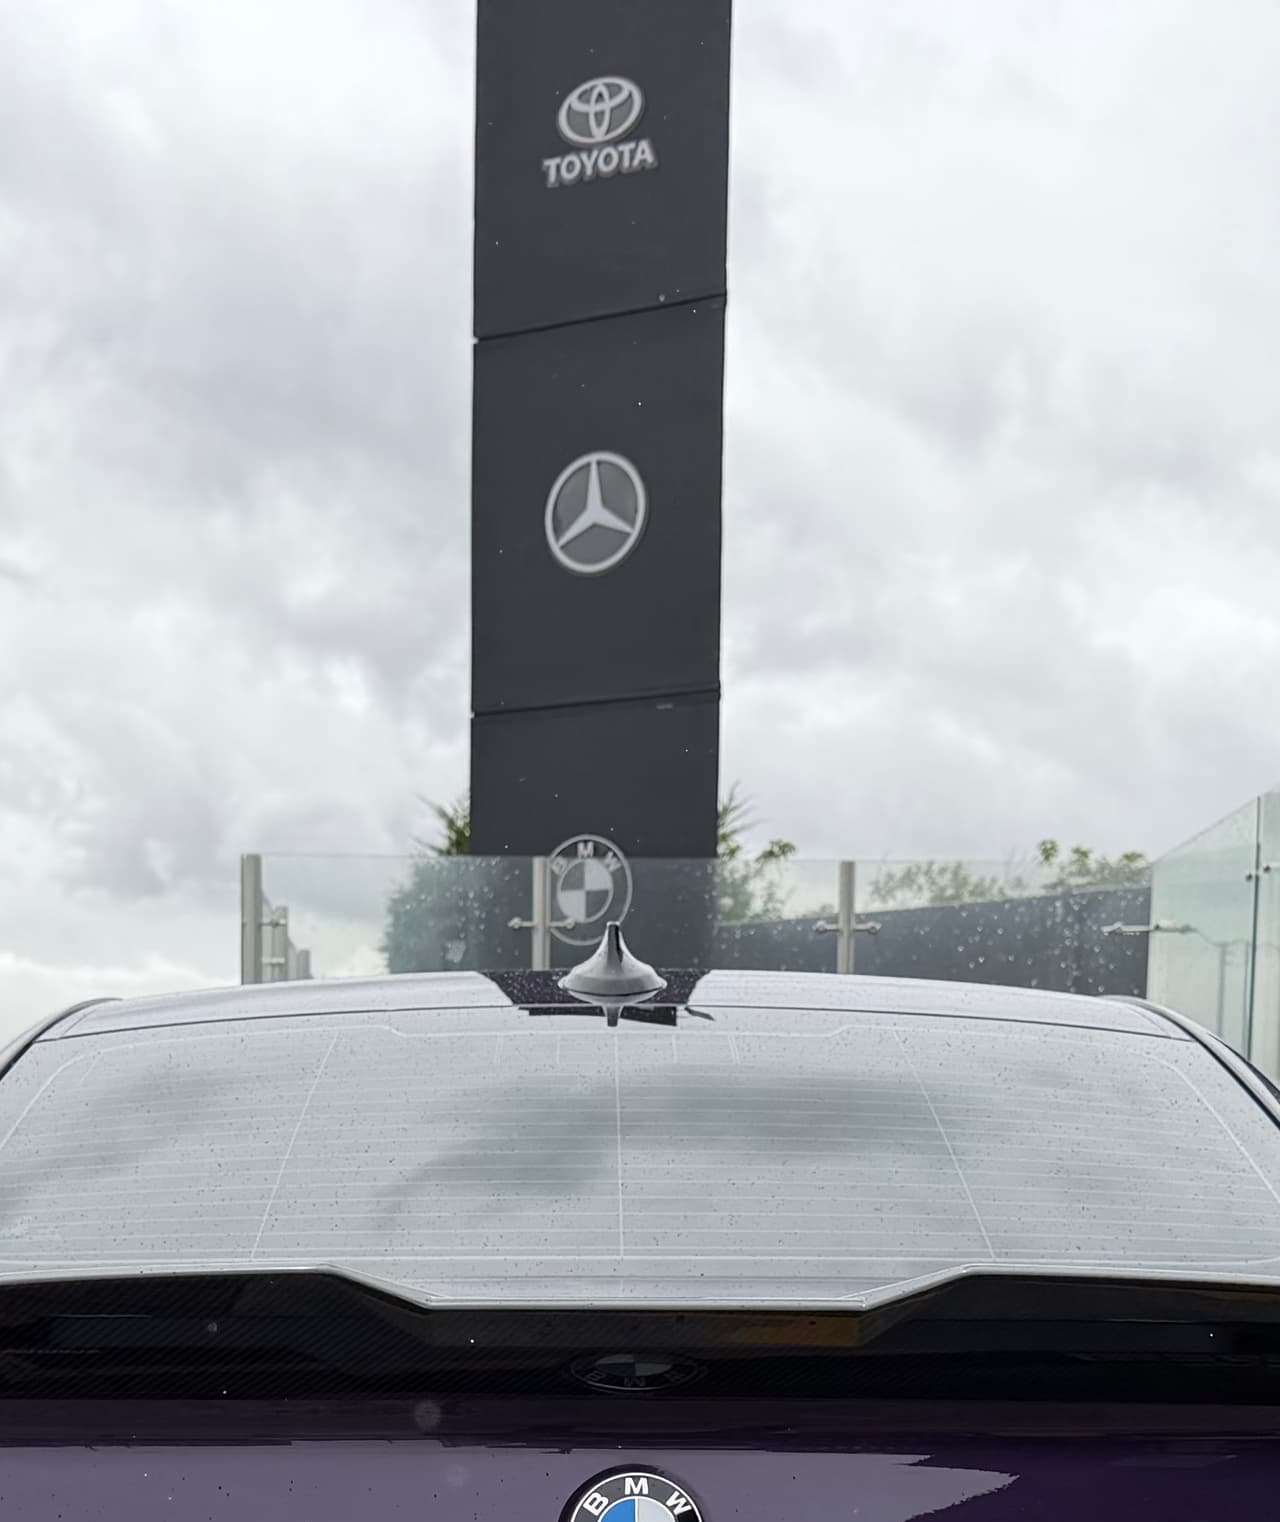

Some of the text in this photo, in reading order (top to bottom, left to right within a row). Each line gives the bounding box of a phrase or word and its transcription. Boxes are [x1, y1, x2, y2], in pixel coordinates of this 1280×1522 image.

[543, 138, 657, 187] TOYOTA
[551, 841, 622, 875] BMW
[583, 1477, 692, 1516] BMW
